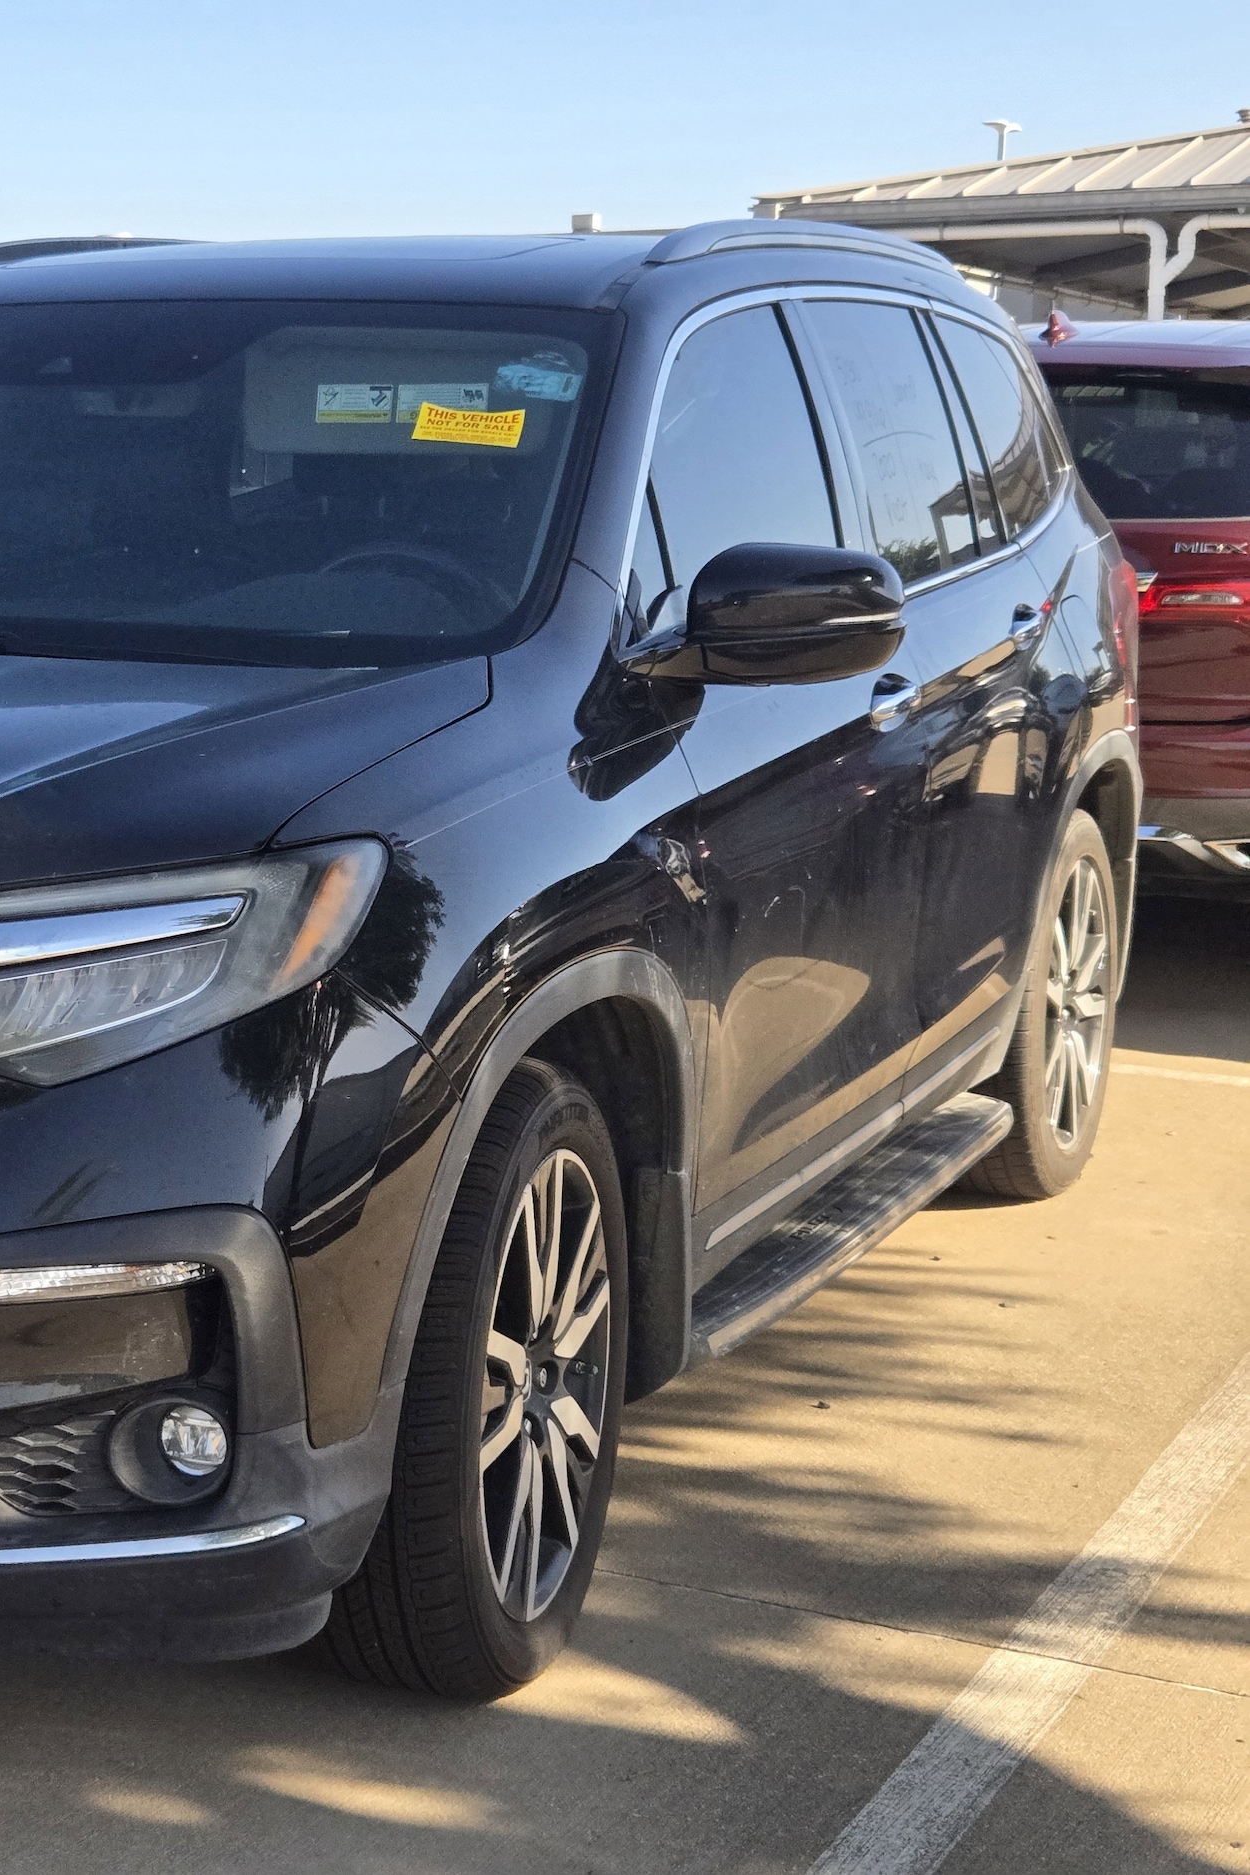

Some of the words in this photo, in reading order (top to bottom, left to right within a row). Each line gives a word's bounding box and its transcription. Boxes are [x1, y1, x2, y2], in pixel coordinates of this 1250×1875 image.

[427, 407, 457, 420] THIS
[461, 413, 521, 424] VEHICLE
[426, 418, 450, 426] NOT
[455, 421, 480, 429] FOR
[484, 424, 516, 432] SALE
[1174, 541, 1248, 555] MDX
